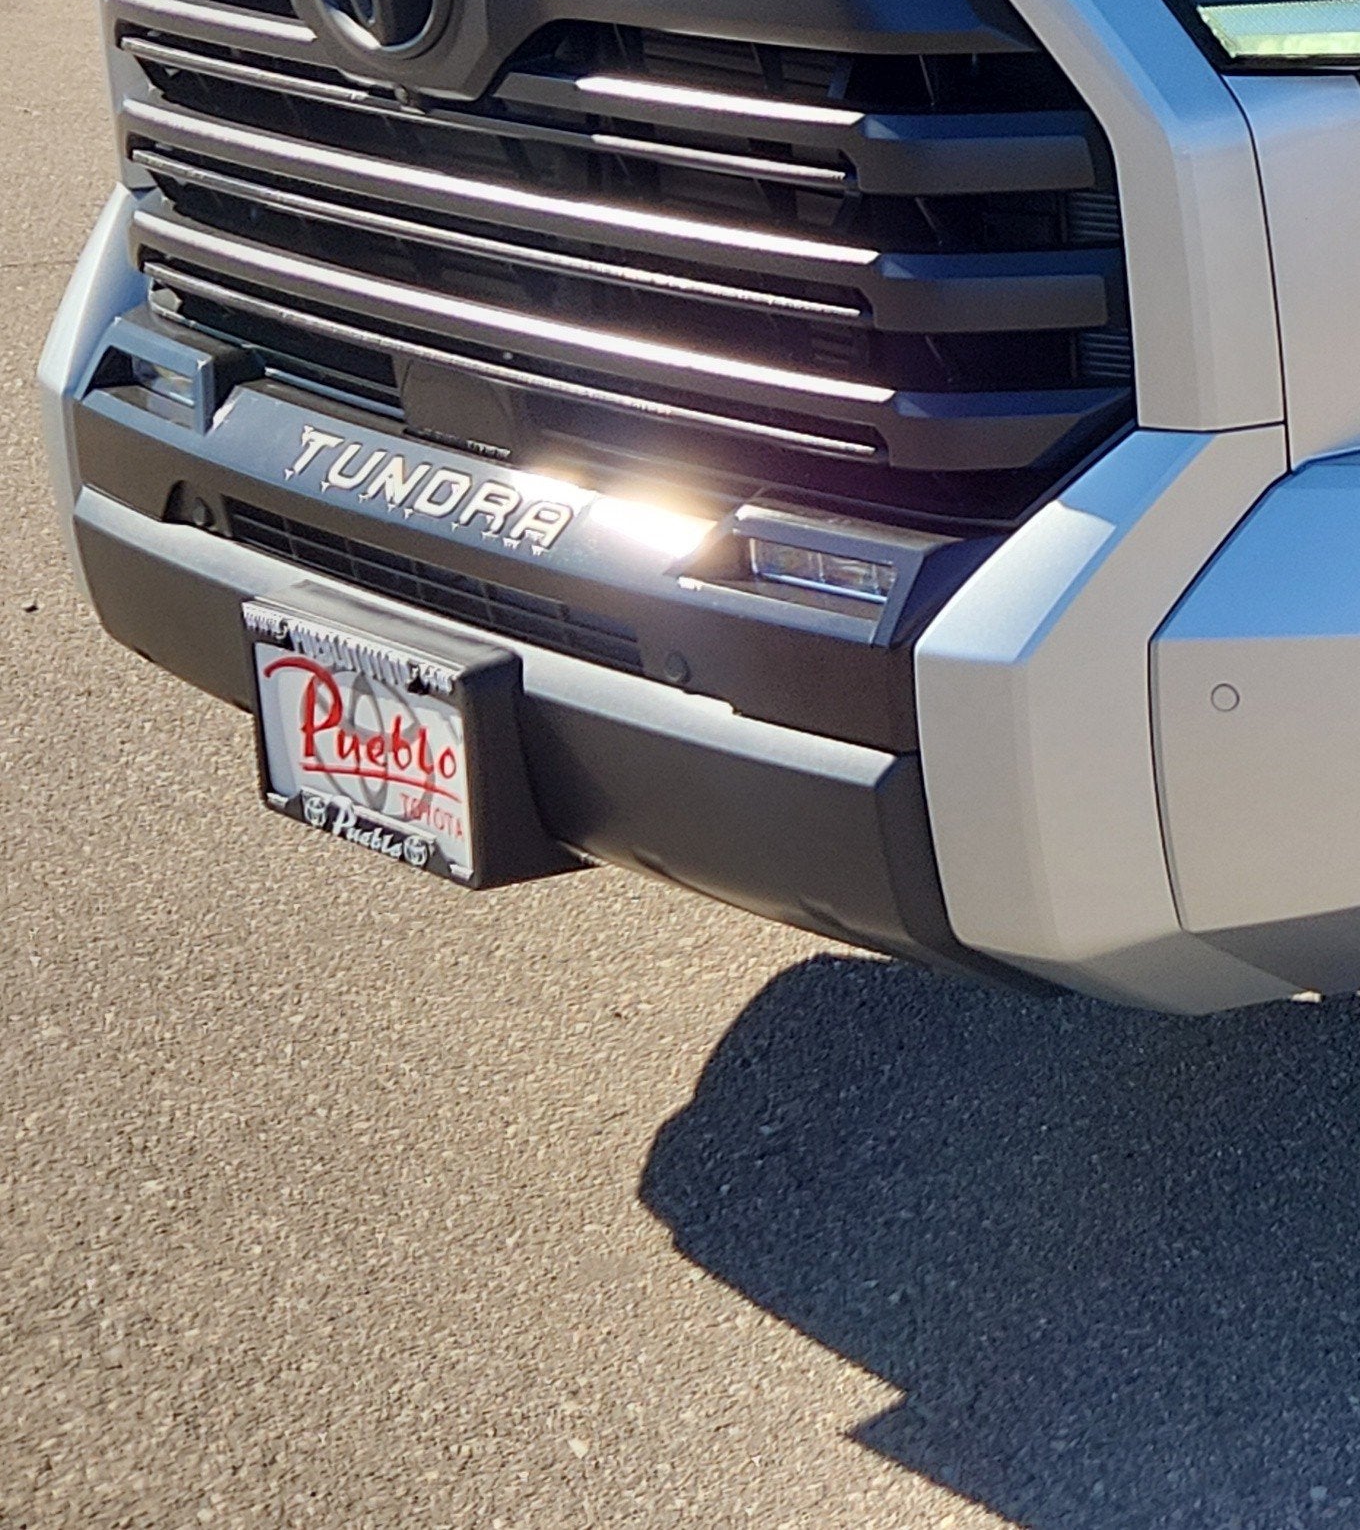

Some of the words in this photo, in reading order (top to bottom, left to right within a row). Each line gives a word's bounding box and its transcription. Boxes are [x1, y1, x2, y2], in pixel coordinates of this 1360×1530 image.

[288, 425, 575, 551] TUNDRA
[263, 657, 457, 778] Pueblo
[331, 794, 403, 858] Pueblo
